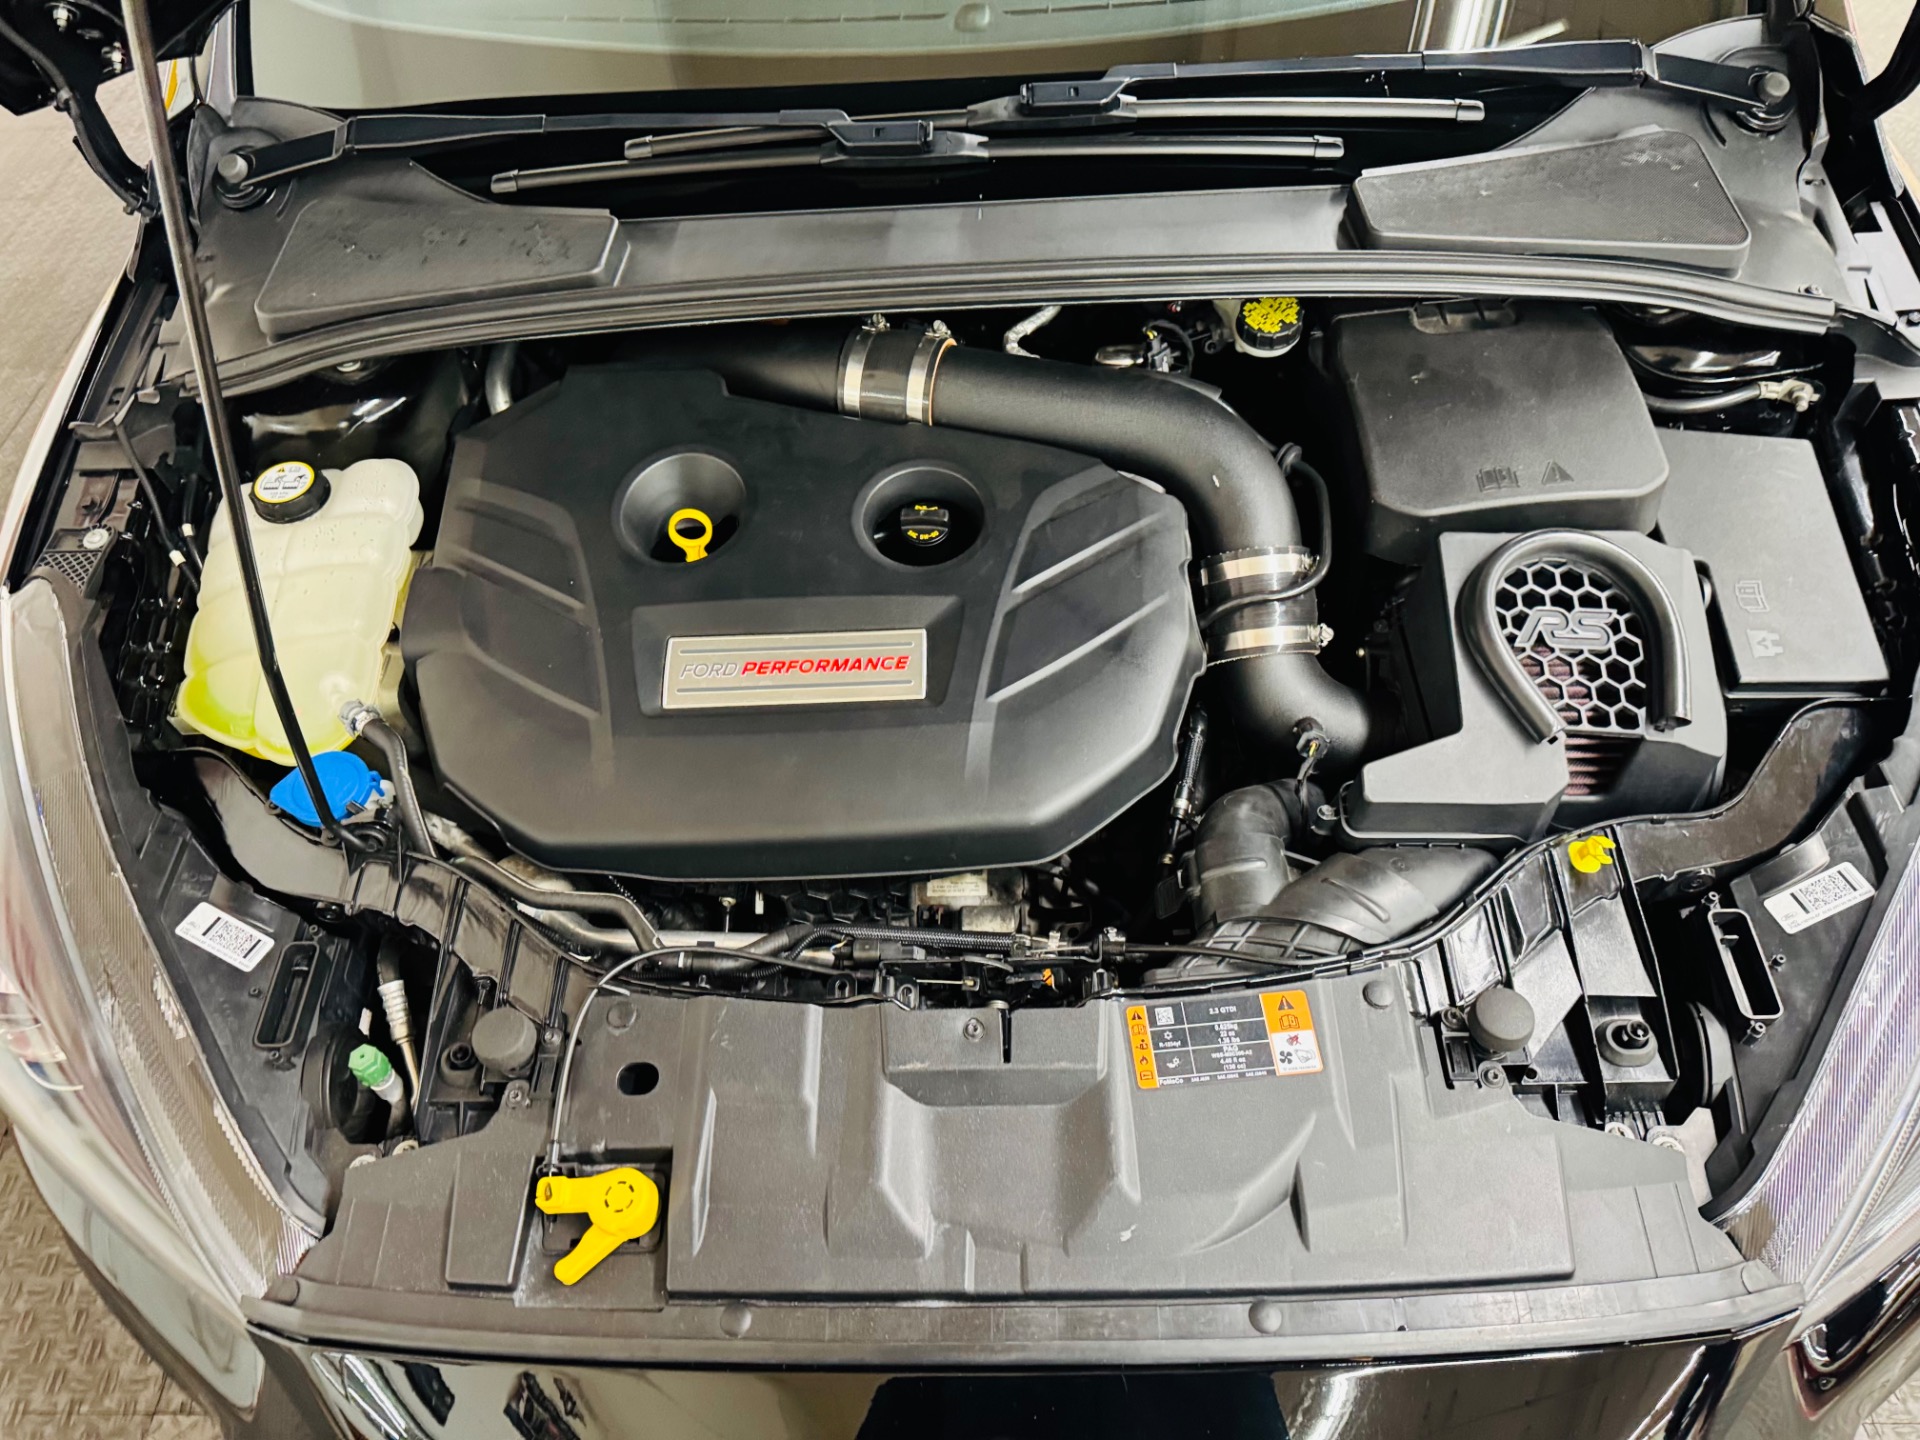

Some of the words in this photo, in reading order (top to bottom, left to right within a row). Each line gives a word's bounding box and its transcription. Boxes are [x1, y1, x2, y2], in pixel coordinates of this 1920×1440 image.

[1514, 605, 1617, 650] RS
[679, 662, 738, 680] FORD
[740, 655, 911, 676] PERFORMANCE
[1209, 1007, 1219, 1015] 2.3
